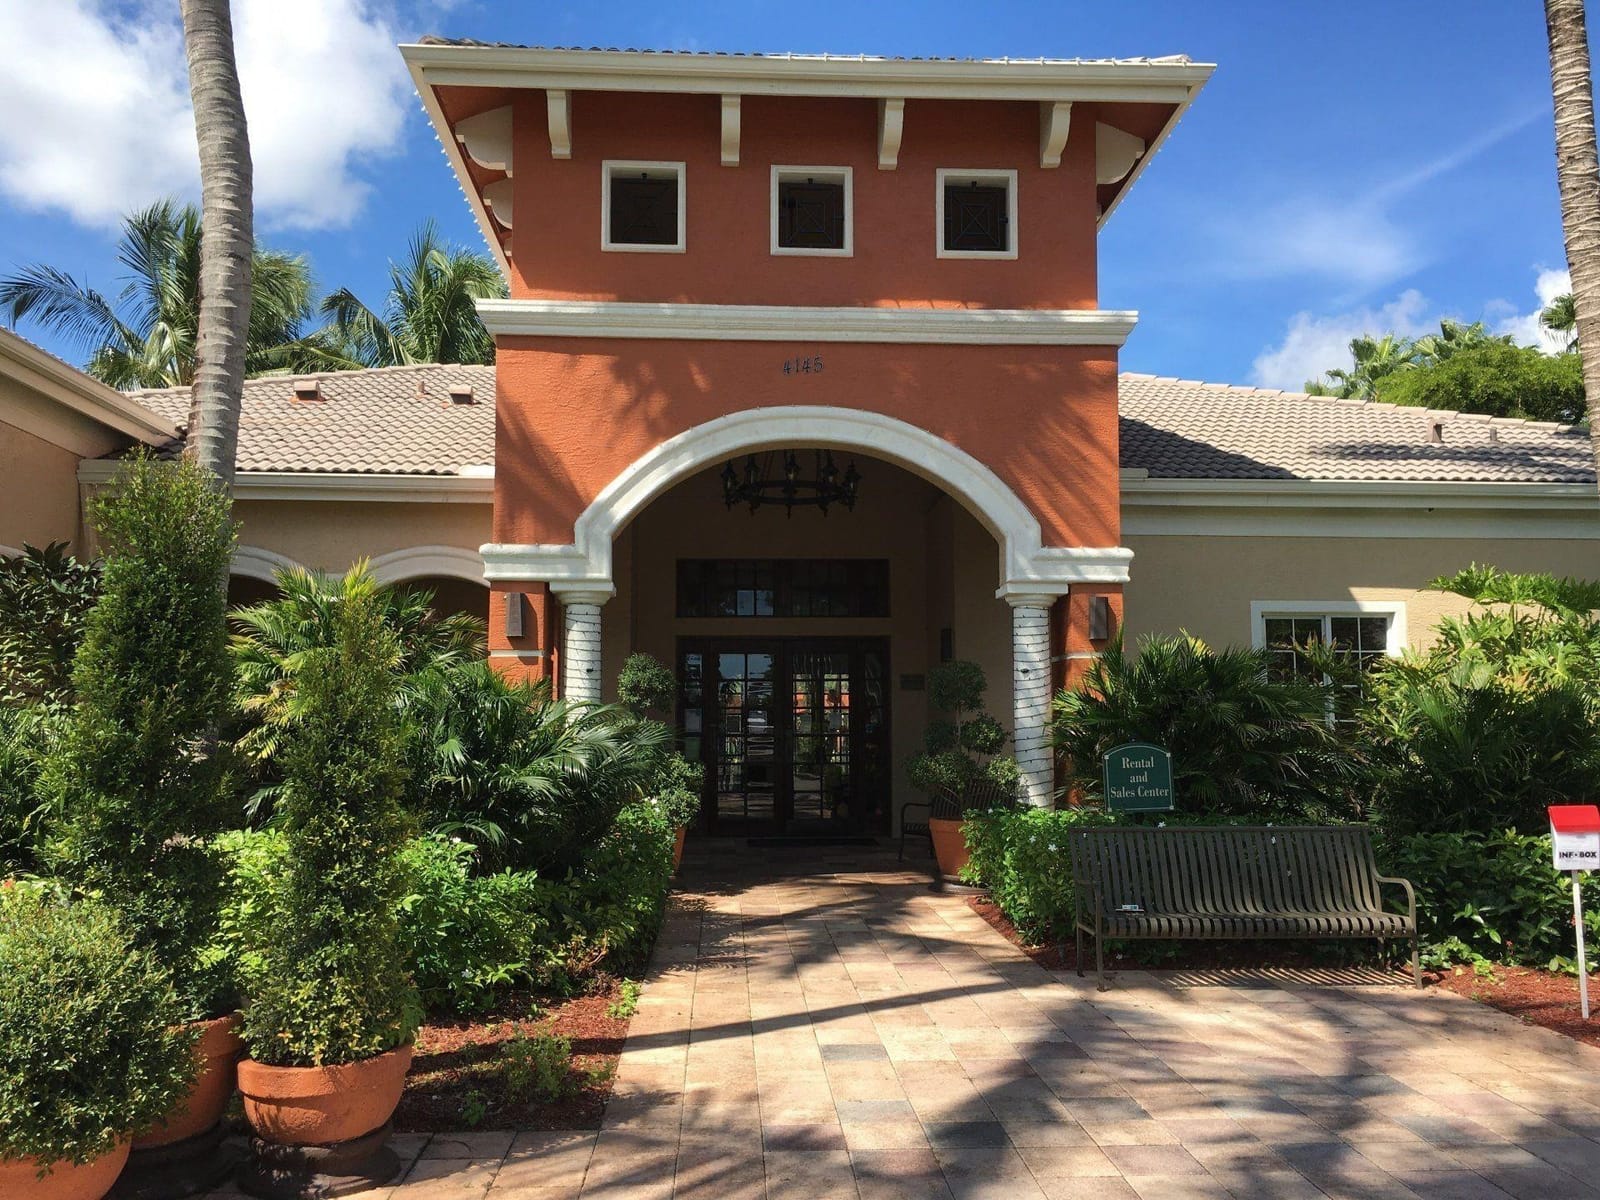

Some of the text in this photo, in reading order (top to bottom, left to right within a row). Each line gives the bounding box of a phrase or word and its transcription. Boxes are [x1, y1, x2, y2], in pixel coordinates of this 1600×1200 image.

[783, 355, 824, 374] 4145
[1122, 756, 1154, 769] Rental
[1129, 771, 1148, 783] and
[1110, 785, 1170, 799] Sales Center
